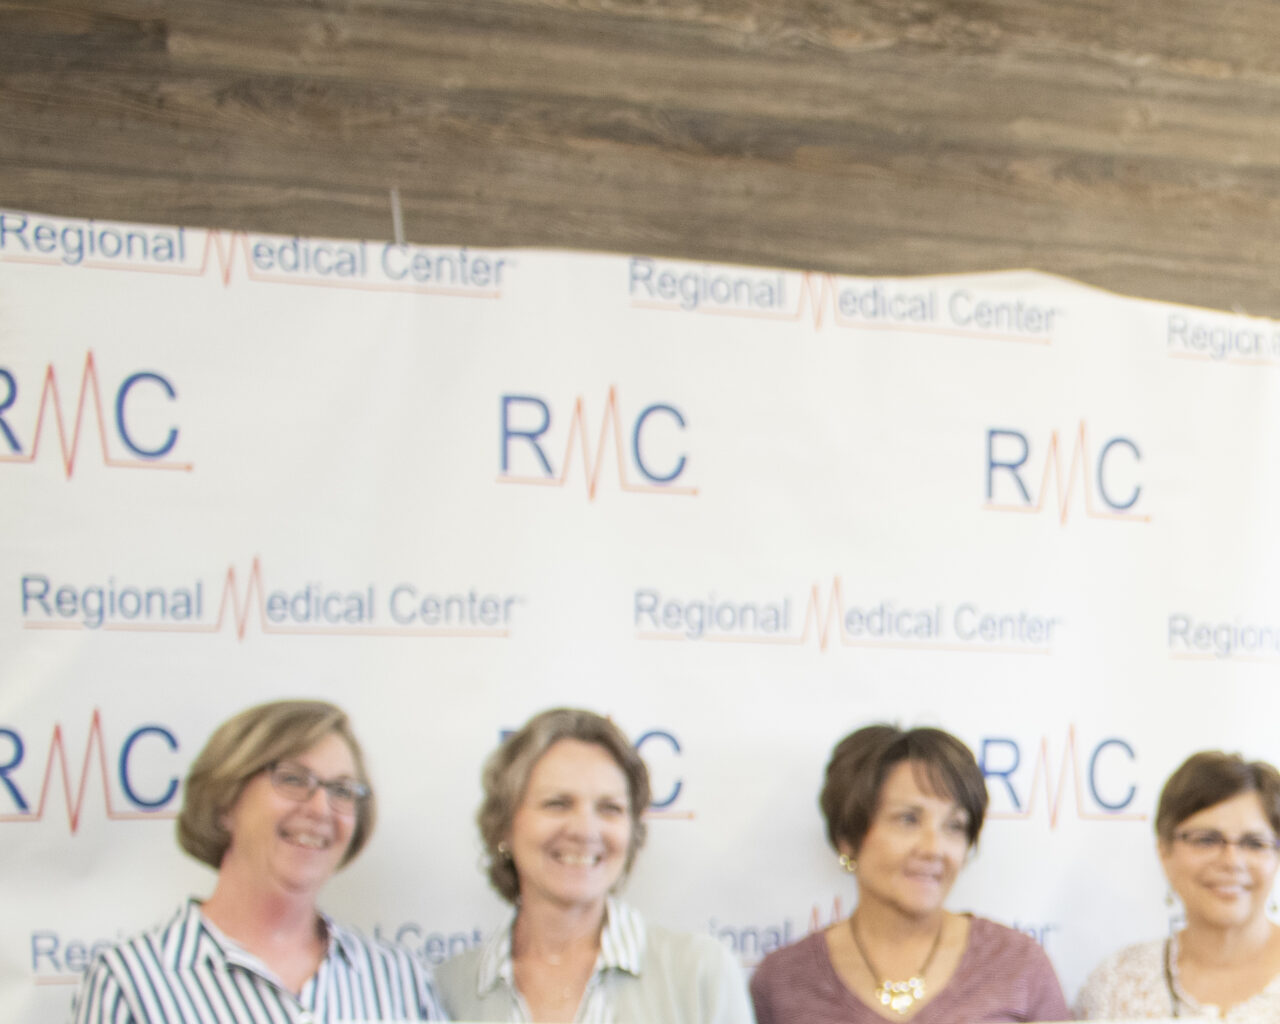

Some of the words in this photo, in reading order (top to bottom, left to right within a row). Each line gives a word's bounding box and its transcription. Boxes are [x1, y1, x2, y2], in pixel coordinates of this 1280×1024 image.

[0, 213, 187, 265] Regional
[381, 242, 506, 287] Center
[628, 256, 787, 311] Regional
[948, 290, 1055, 335] Center
[499, 385, 690, 501] RMC
[984, 419, 1143, 525] RMC
[21, 575, 202, 629] Regional
[389, 585, 514, 626] Center
[633, 589, 791, 640] Regional
[953, 603, 1055, 645] Center
